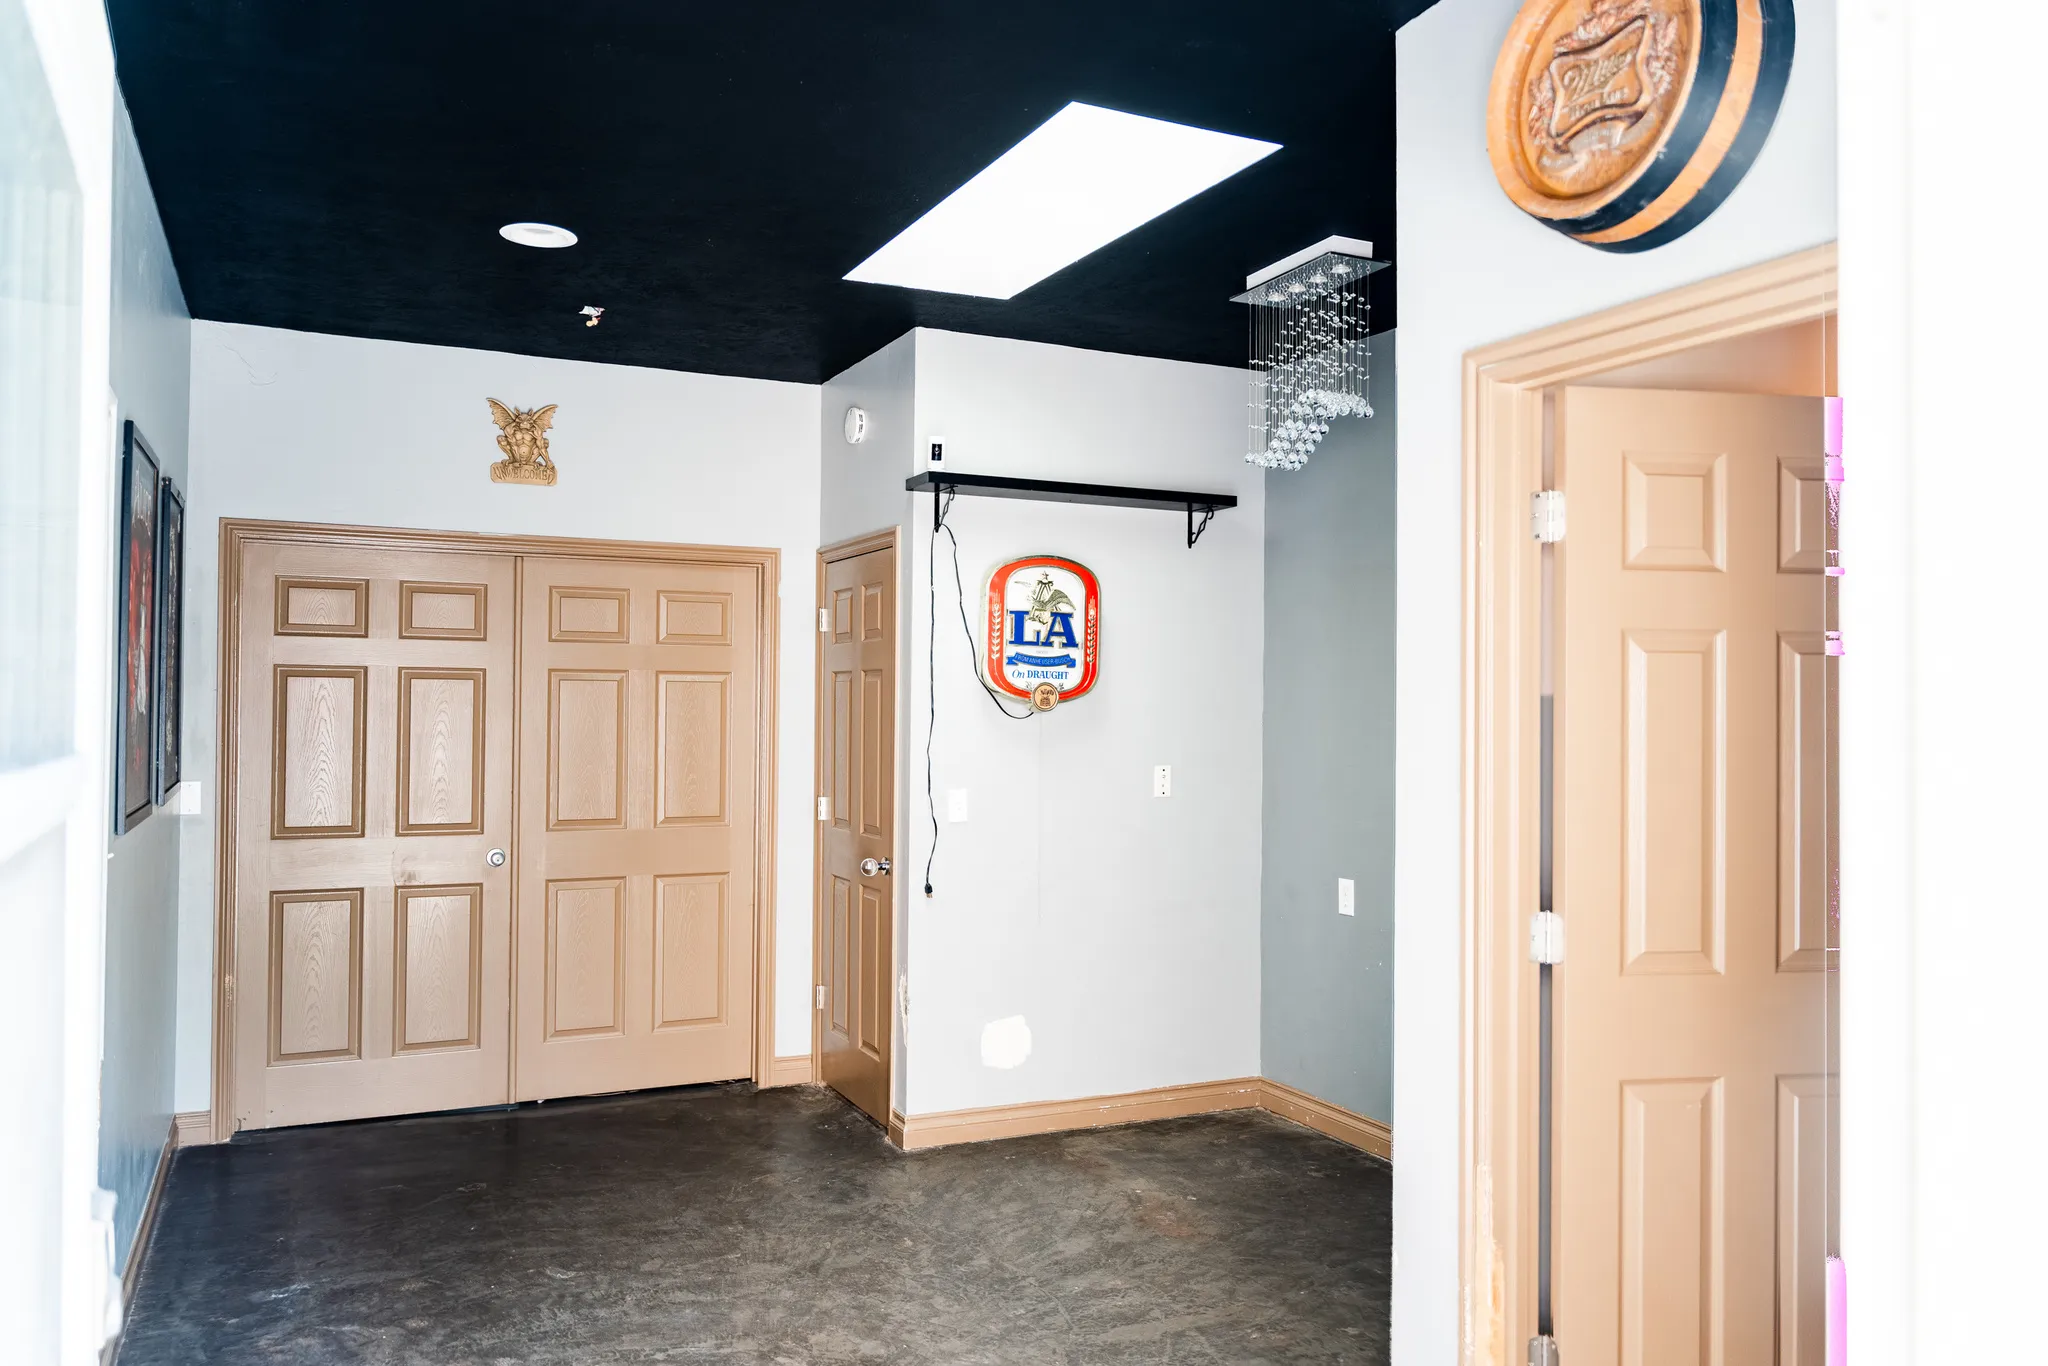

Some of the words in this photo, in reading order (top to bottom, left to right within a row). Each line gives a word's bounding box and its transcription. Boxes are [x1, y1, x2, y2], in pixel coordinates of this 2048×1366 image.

[1009, 610, 1078, 648] LA
[1014, 653, 1029, 662] FROM
[1012, 669, 1025, 679] On
[1027, 670, 1069, 680] DRAUGHT
